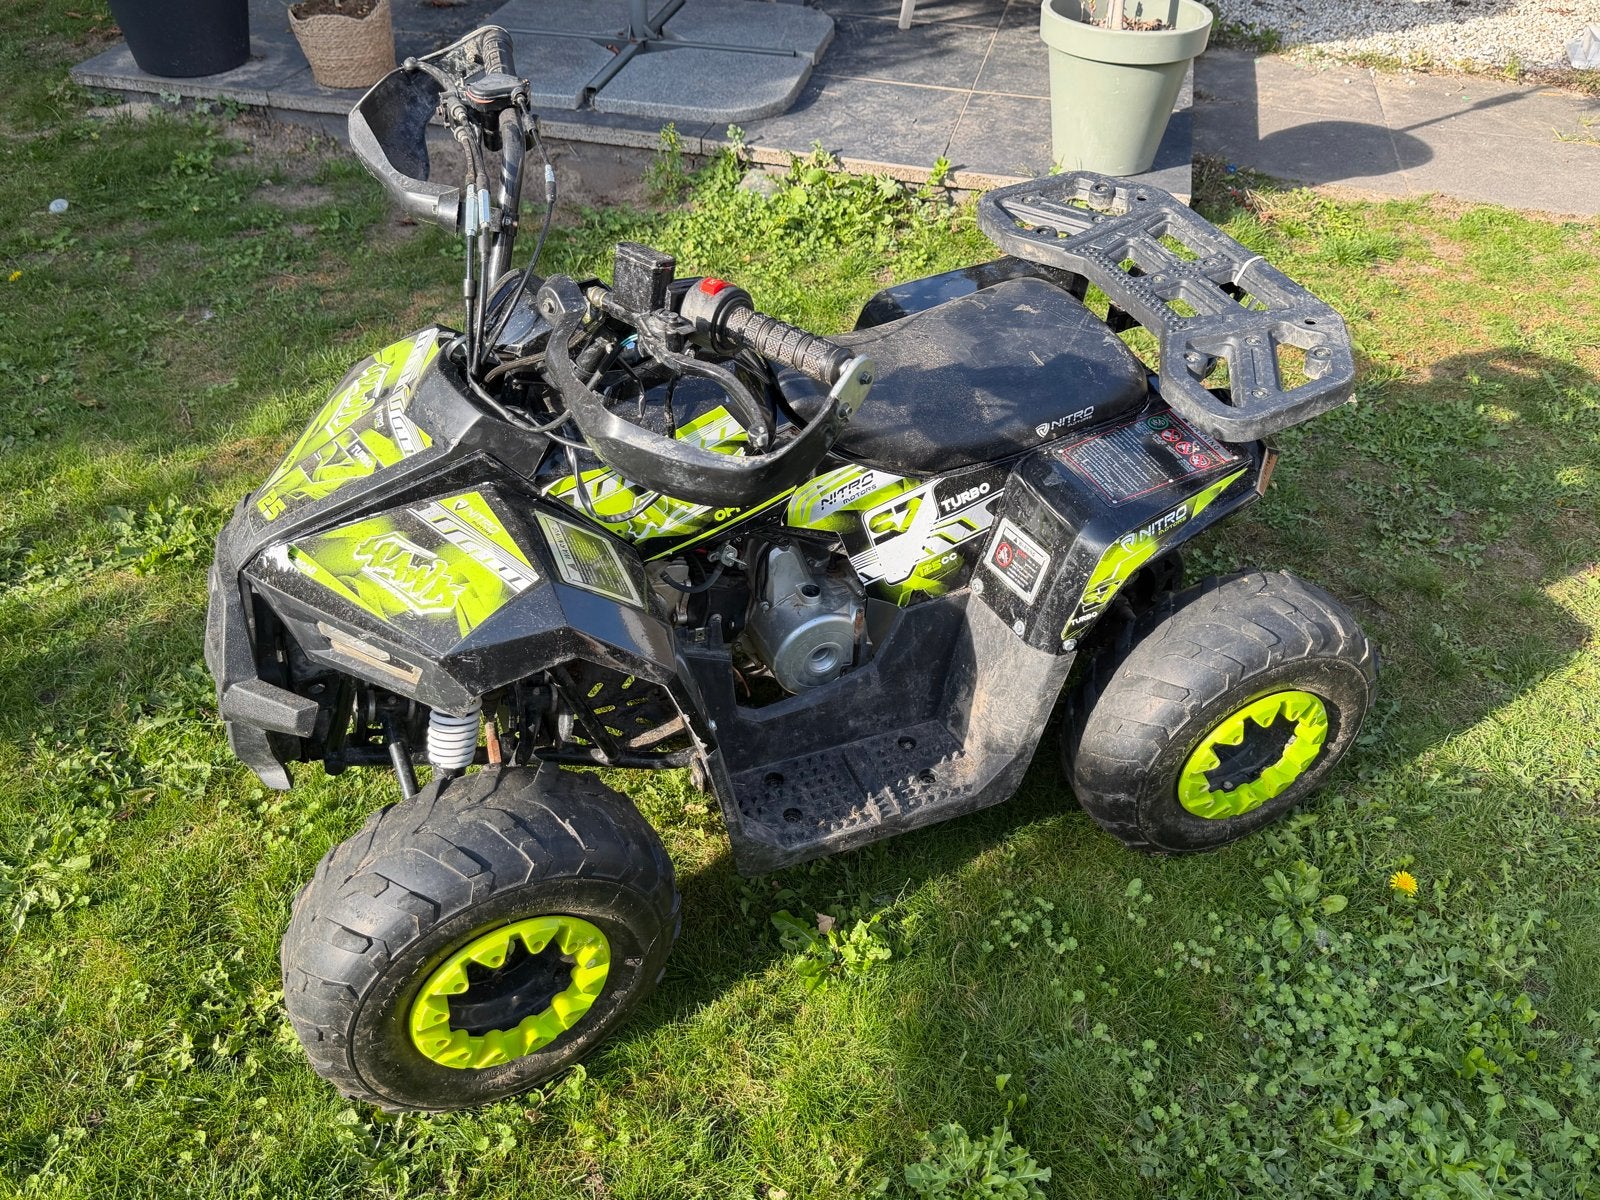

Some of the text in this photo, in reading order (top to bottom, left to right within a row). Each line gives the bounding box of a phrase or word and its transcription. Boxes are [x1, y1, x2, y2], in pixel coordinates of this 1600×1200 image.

[1051, 405, 1095, 430] NITRO
[350, 444, 374, 468] TURBO
[821, 472, 874, 511] NITRO
[842, 484, 877, 504] MOTORS
[940, 482, 991, 512] TURBO
[464, 505, 501, 534] NITRO
[1139, 504, 1188, 542] NITRO
[553, 525, 574, 561] WARNING
[1071, 611, 1098, 626] TURBO
